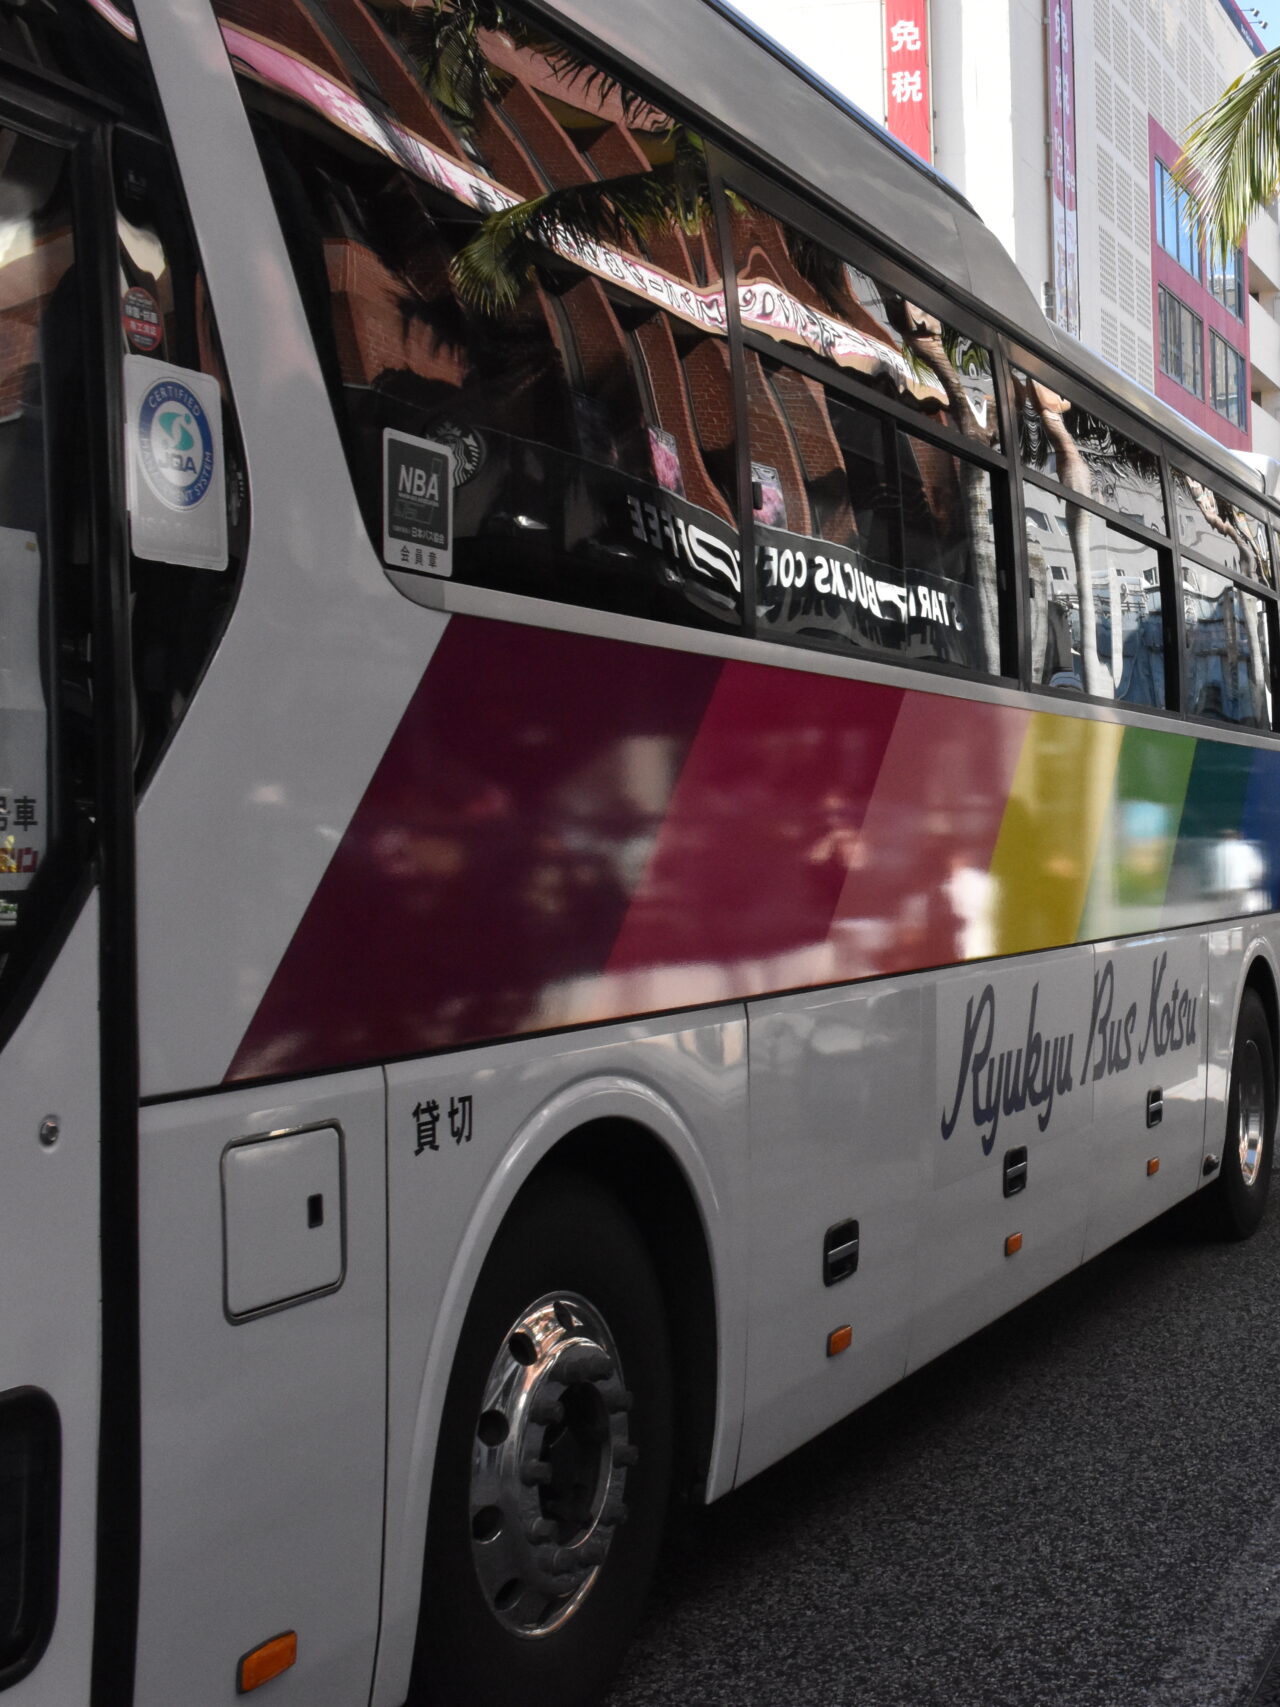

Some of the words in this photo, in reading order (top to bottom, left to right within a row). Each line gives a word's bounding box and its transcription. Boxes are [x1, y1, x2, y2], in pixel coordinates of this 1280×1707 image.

[890, 20, 922, 103] 免税
[149, 385, 201, 417] CERTIFIED
[158, 452, 198, 475] JQA
[399, 464, 440, 501] NBA
[941, 981, 1073, 1156] Ryukyu
[1080, 960, 1137, 1085] Bus
[1138, 950, 1197, 1064] Kotsu
[412, 1095, 474, 1156] 貸切
